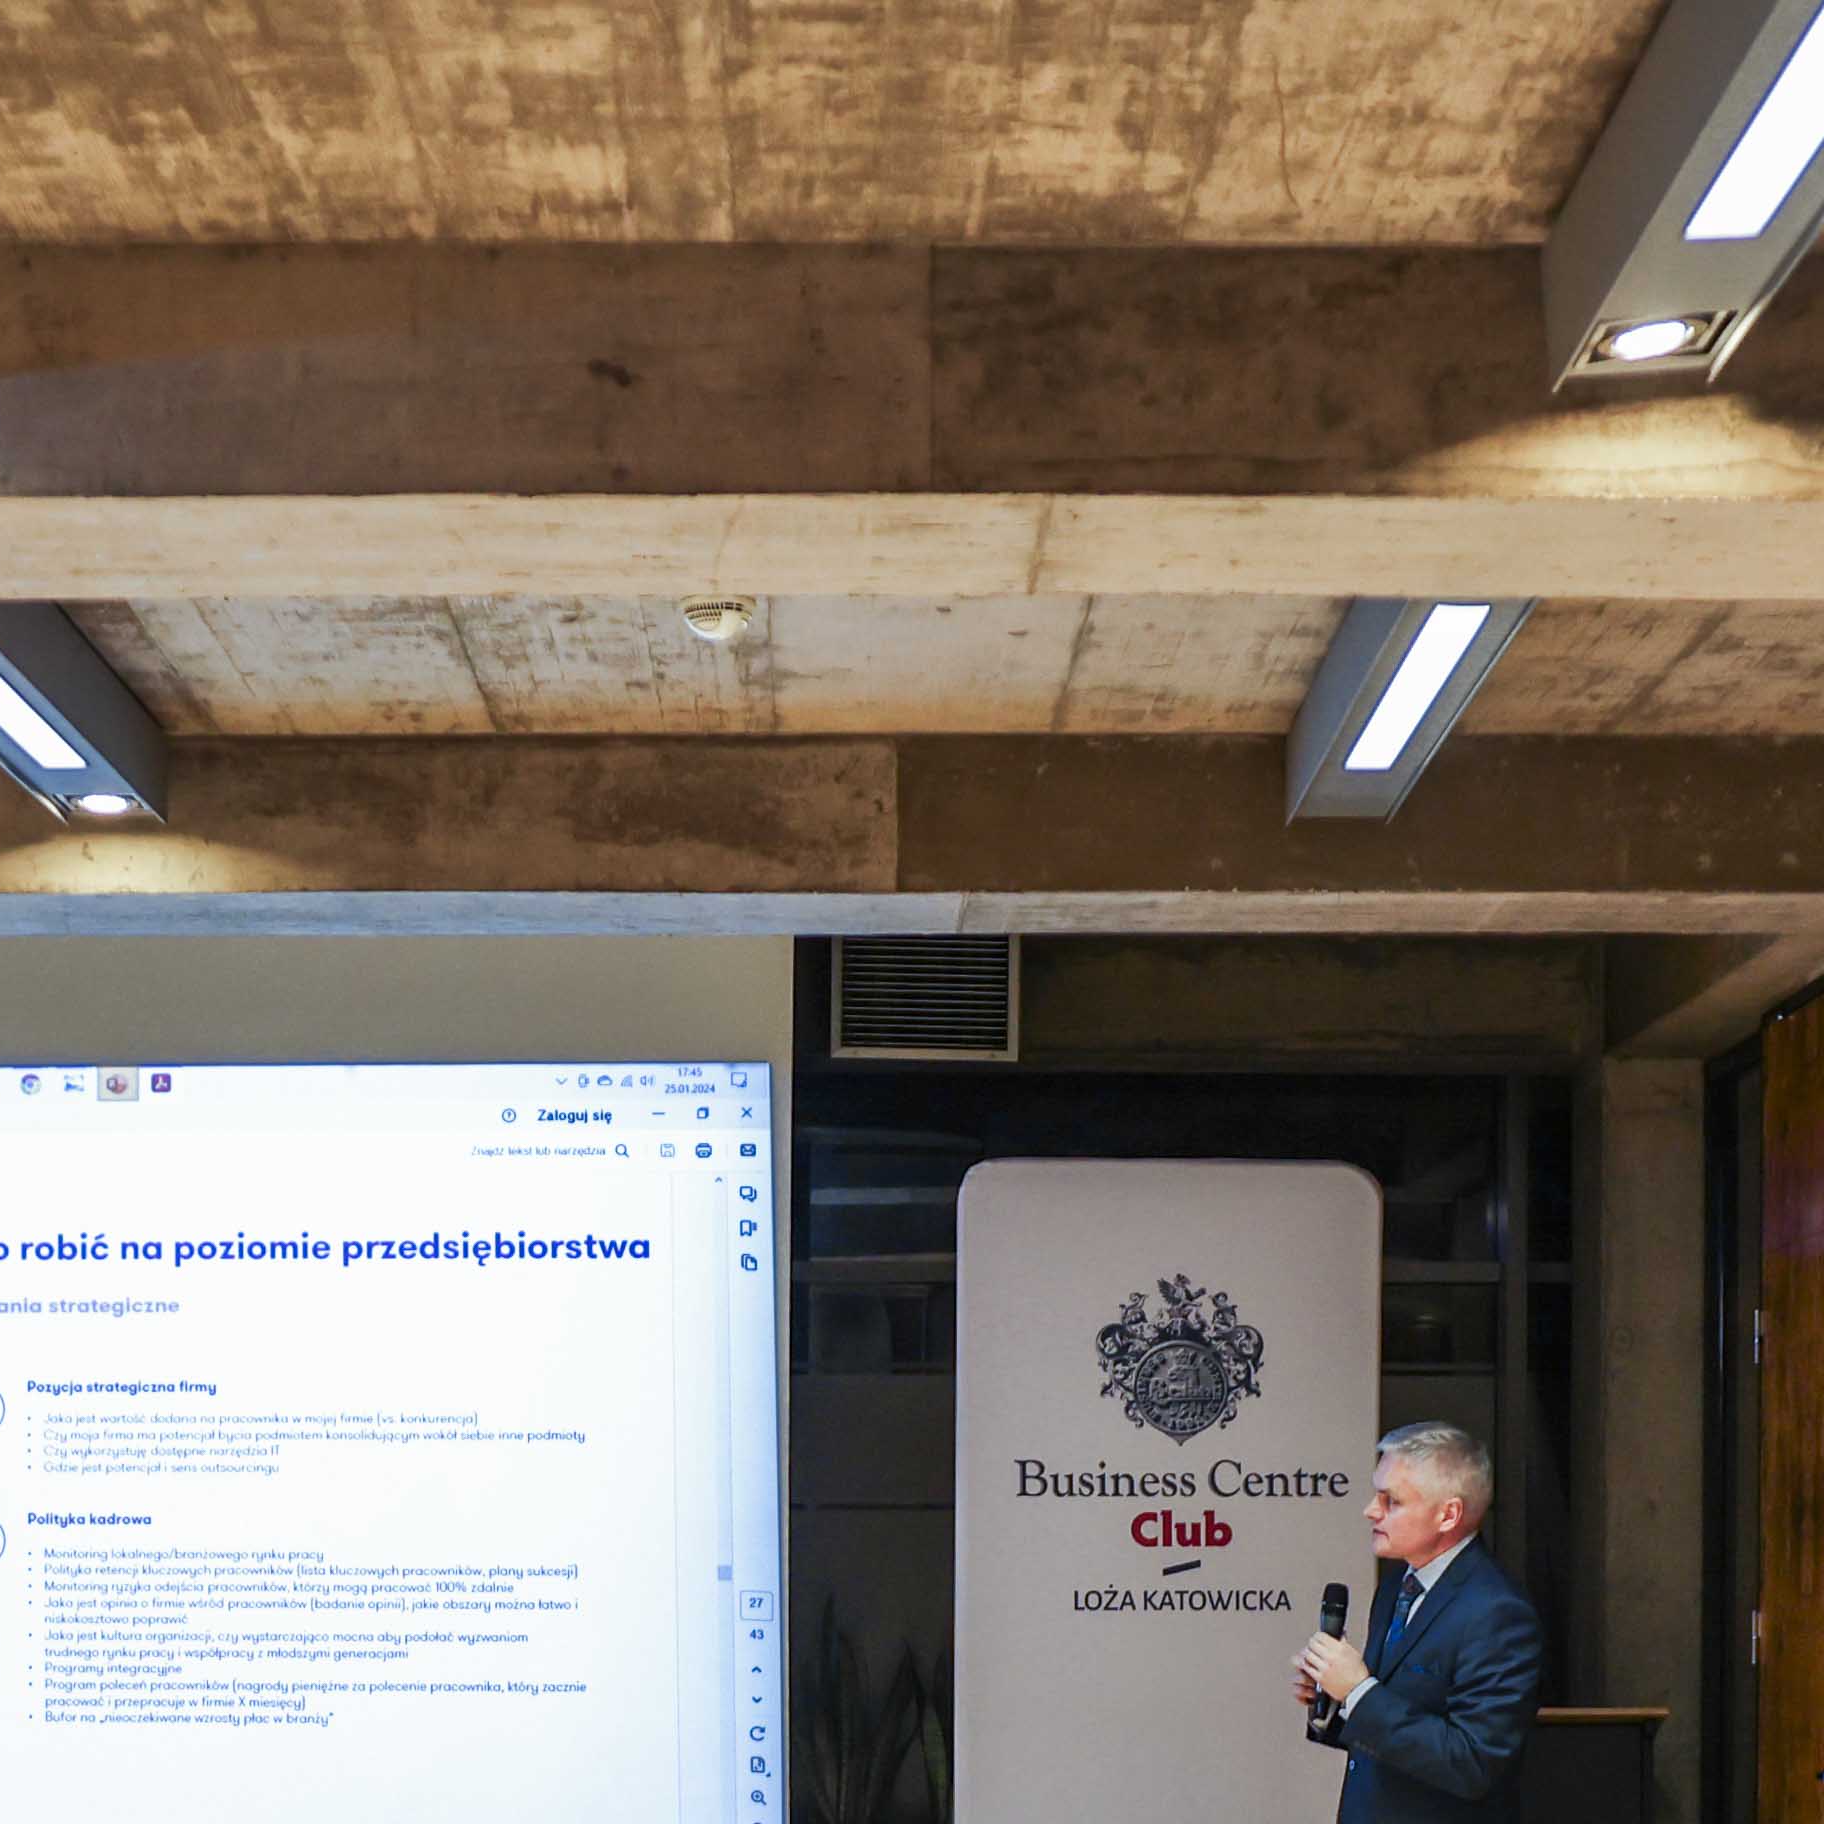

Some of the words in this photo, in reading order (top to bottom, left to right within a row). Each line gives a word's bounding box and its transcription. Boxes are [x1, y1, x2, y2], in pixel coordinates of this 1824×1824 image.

[537, 1109, 588, 1124] Zaloguj
[592, 1109, 613, 1125] się
[21, 1233, 108, 1261] robić
[121, 1241, 162, 1260] na
[175, 1231, 330, 1267] poziomie
[342, 1230, 650, 1266] przedsiębiorstwa
[49, 1297, 179, 1317] strategiczne
[26, 1381, 83, 1397] Pozycja
[86, 1382, 176, 1396] strategiczna
[178, 1380, 218, 1396] firmy
[1014, 1460, 1196, 1498] Business
[1208, 1461, 1350, 1498] Centre
[26, 1513, 86, 1529] Polityka
[88, 1513, 153, 1525] kadrowa
[1130, 1510, 1232, 1548] Club
[43, 1548, 109, 1562] Monitoring
[110, 1549, 249, 1562] lokalnego/branżowego
[250, 1549, 286, 1562] rynku
[287, 1553, 325, 1565] pracy
[43, 1564, 93, 1577] Polityka
[94, 1566, 140, 1577] retencji
[141, 1566, 212, 1579] kluczowych
[213, 1565, 294, 1576] pracowników
[328, 1565, 400, 1578] kluczowych
[401, 1567, 486, 1579] pracowników,
[487, 1566, 525, 1580] plany
[43, 1580, 109, 1594] Monitoring
[111, 1582, 152, 1595] ryzyka
[154, 1583, 205, 1595] odejścia
[207, 1582, 289, 1595] pracowników,
[292, 1582, 332, 1595] którzy
[332, 1584, 369, 1596] mogą
[370, 1583, 432, 1595] pracować
[435, 1582, 468, 1593] 100%
[470, 1582, 515, 1593] zdalnie
[45, 1598, 74, 1608] Jaka
[76, 1600, 97, 1611] jest
[100, 1600, 140, 1611] opinia
[139, 1600, 149, 1608] o
[151, 1598, 186, 1608] firmie
[187, 1598, 225, 1608] wśród
[227, 1600, 308, 1612] pracowników
[411, 1599, 440, 1612] jakie
[442, 1600, 492, 1613] obszary
[494, 1601, 536, 1609] można
[535, 1600, 572, 1610] łatwo
[574, 1599, 580, 1610] i
[749, 1597, 764, 1608] 27
[1074, 1584, 1136, 1612] LOŻA
[1144, 1590, 1291, 1612] KATOWICKA
[43, 1614, 130, 1624] niskokosztowo
[131, 1614, 188, 1627] poprawić
[46, 1631, 75, 1640] Jaka
[76, 1632, 98, 1644] jest
[99, 1631, 143, 1640] kultura
[144, 1633, 215, 1644] organizacji,
[217, 1633, 240, 1644] czy
[241, 1632, 330, 1645] wystarczająco
[332, 1633, 375, 1641] mocna
[376, 1632, 402, 1646] aby
[403, 1632, 454, 1645] podołać
[457, 1634, 530, 1646] wyzwaniom
[749, 1628, 765, 1640] 43
[43, 1648, 100, 1661] trudnego
[102, 1647, 137, 1660] rynku
[138, 1650, 176, 1660] pracy
[177, 1648, 182, 1656] i
[183, 1648, 255, 1661] współpracy
[257, 1650, 264, 1659] z
[266, 1648, 331, 1662] młodszymi
[332, 1651, 410, 1662] generacjami
[43, 1662, 105, 1677] Programy
[106, 1664, 183, 1676] integracyjne
[43, 1678, 97, 1693] Program
[99, 1680, 148, 1693] poleceń
[149, 1680, 230, 1693] pracowników
[291, 1682, 349, 1693] pieniężne
[351, 1684, 367, 1692] za
[367, 1681, 428, 1695] polecenie
[429, 1681, 505, 1694] pracownika,
[506, 1682, 540, 1696] który
[542, 1681, 588, 1692] zacznie
[43, 1696, 104, 1711] pracować
[107, 1698, 111, 1706] i
[113, 1699, 186, 1710] przepracuje
[187, 1699, 198, 1707] w
[200, 1696, 235, 1707] firmie
[237, 1696, 246, 1706] X
[43, 1711, 76, 1723] Bufor
[79, 1715, 96, 1723] na
[193, 1714, 241, 1726] wzrosty
[242, 1713, 269, 1726] płac
